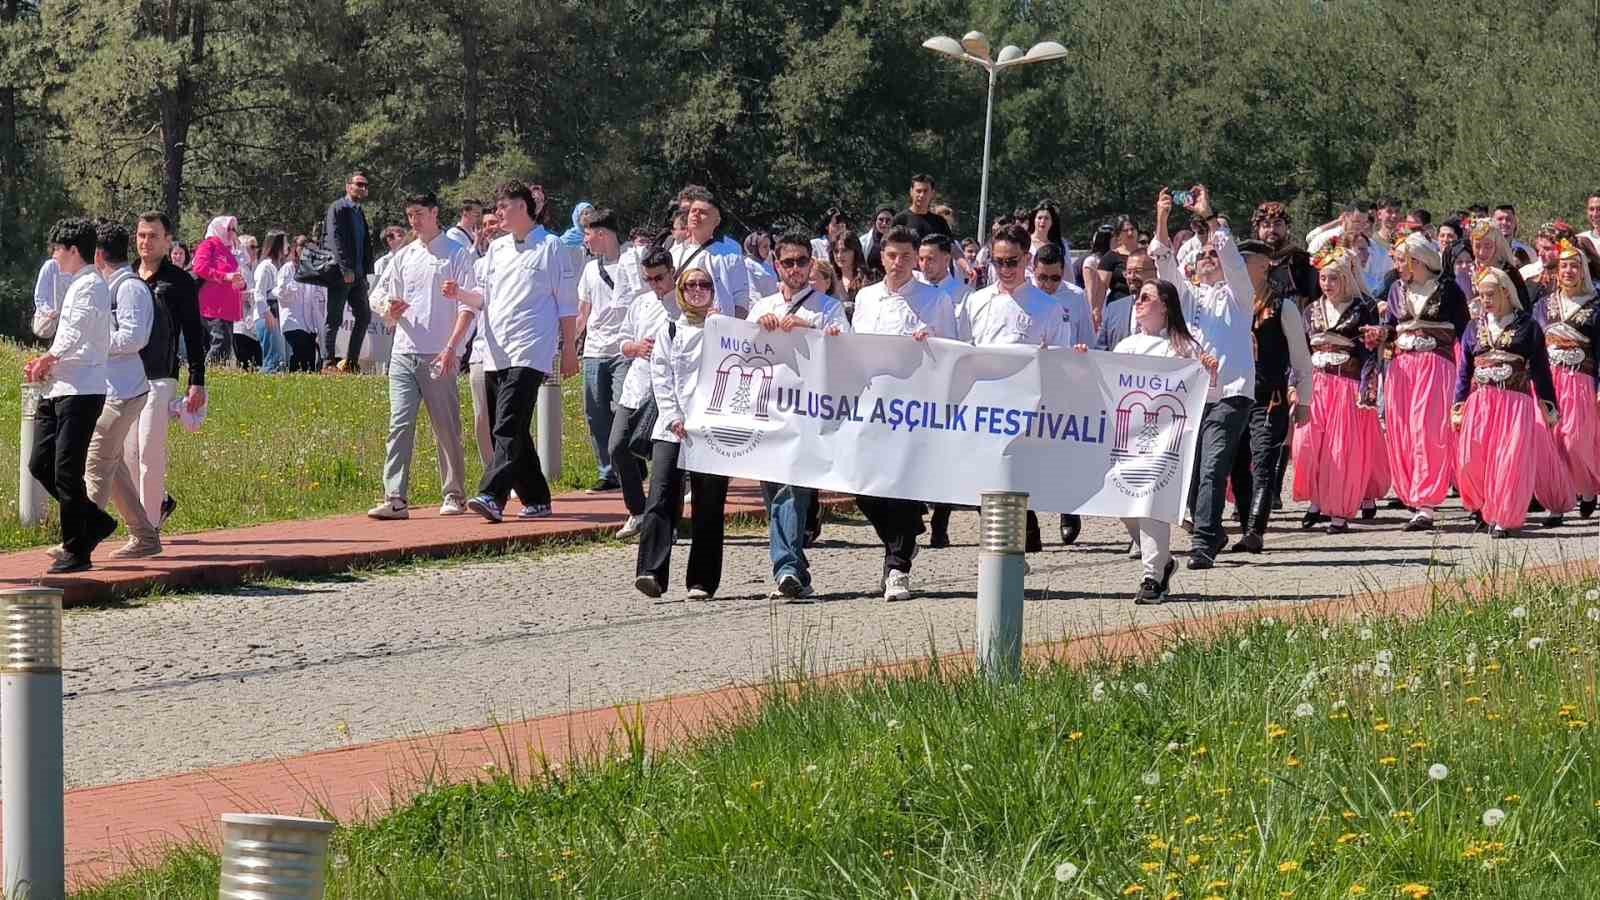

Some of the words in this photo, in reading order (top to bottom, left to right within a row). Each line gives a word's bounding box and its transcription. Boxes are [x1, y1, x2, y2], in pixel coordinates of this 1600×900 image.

[720, 335, 775, 355] MUĞLA
[1119, 374, 1188, 393] MUĞLA
[776, 387, 864, 422] ULUSAL
[869, 397, 968, 433] AŞÇILIK
[974, 405, 1107, 444] FESTİVALİ
